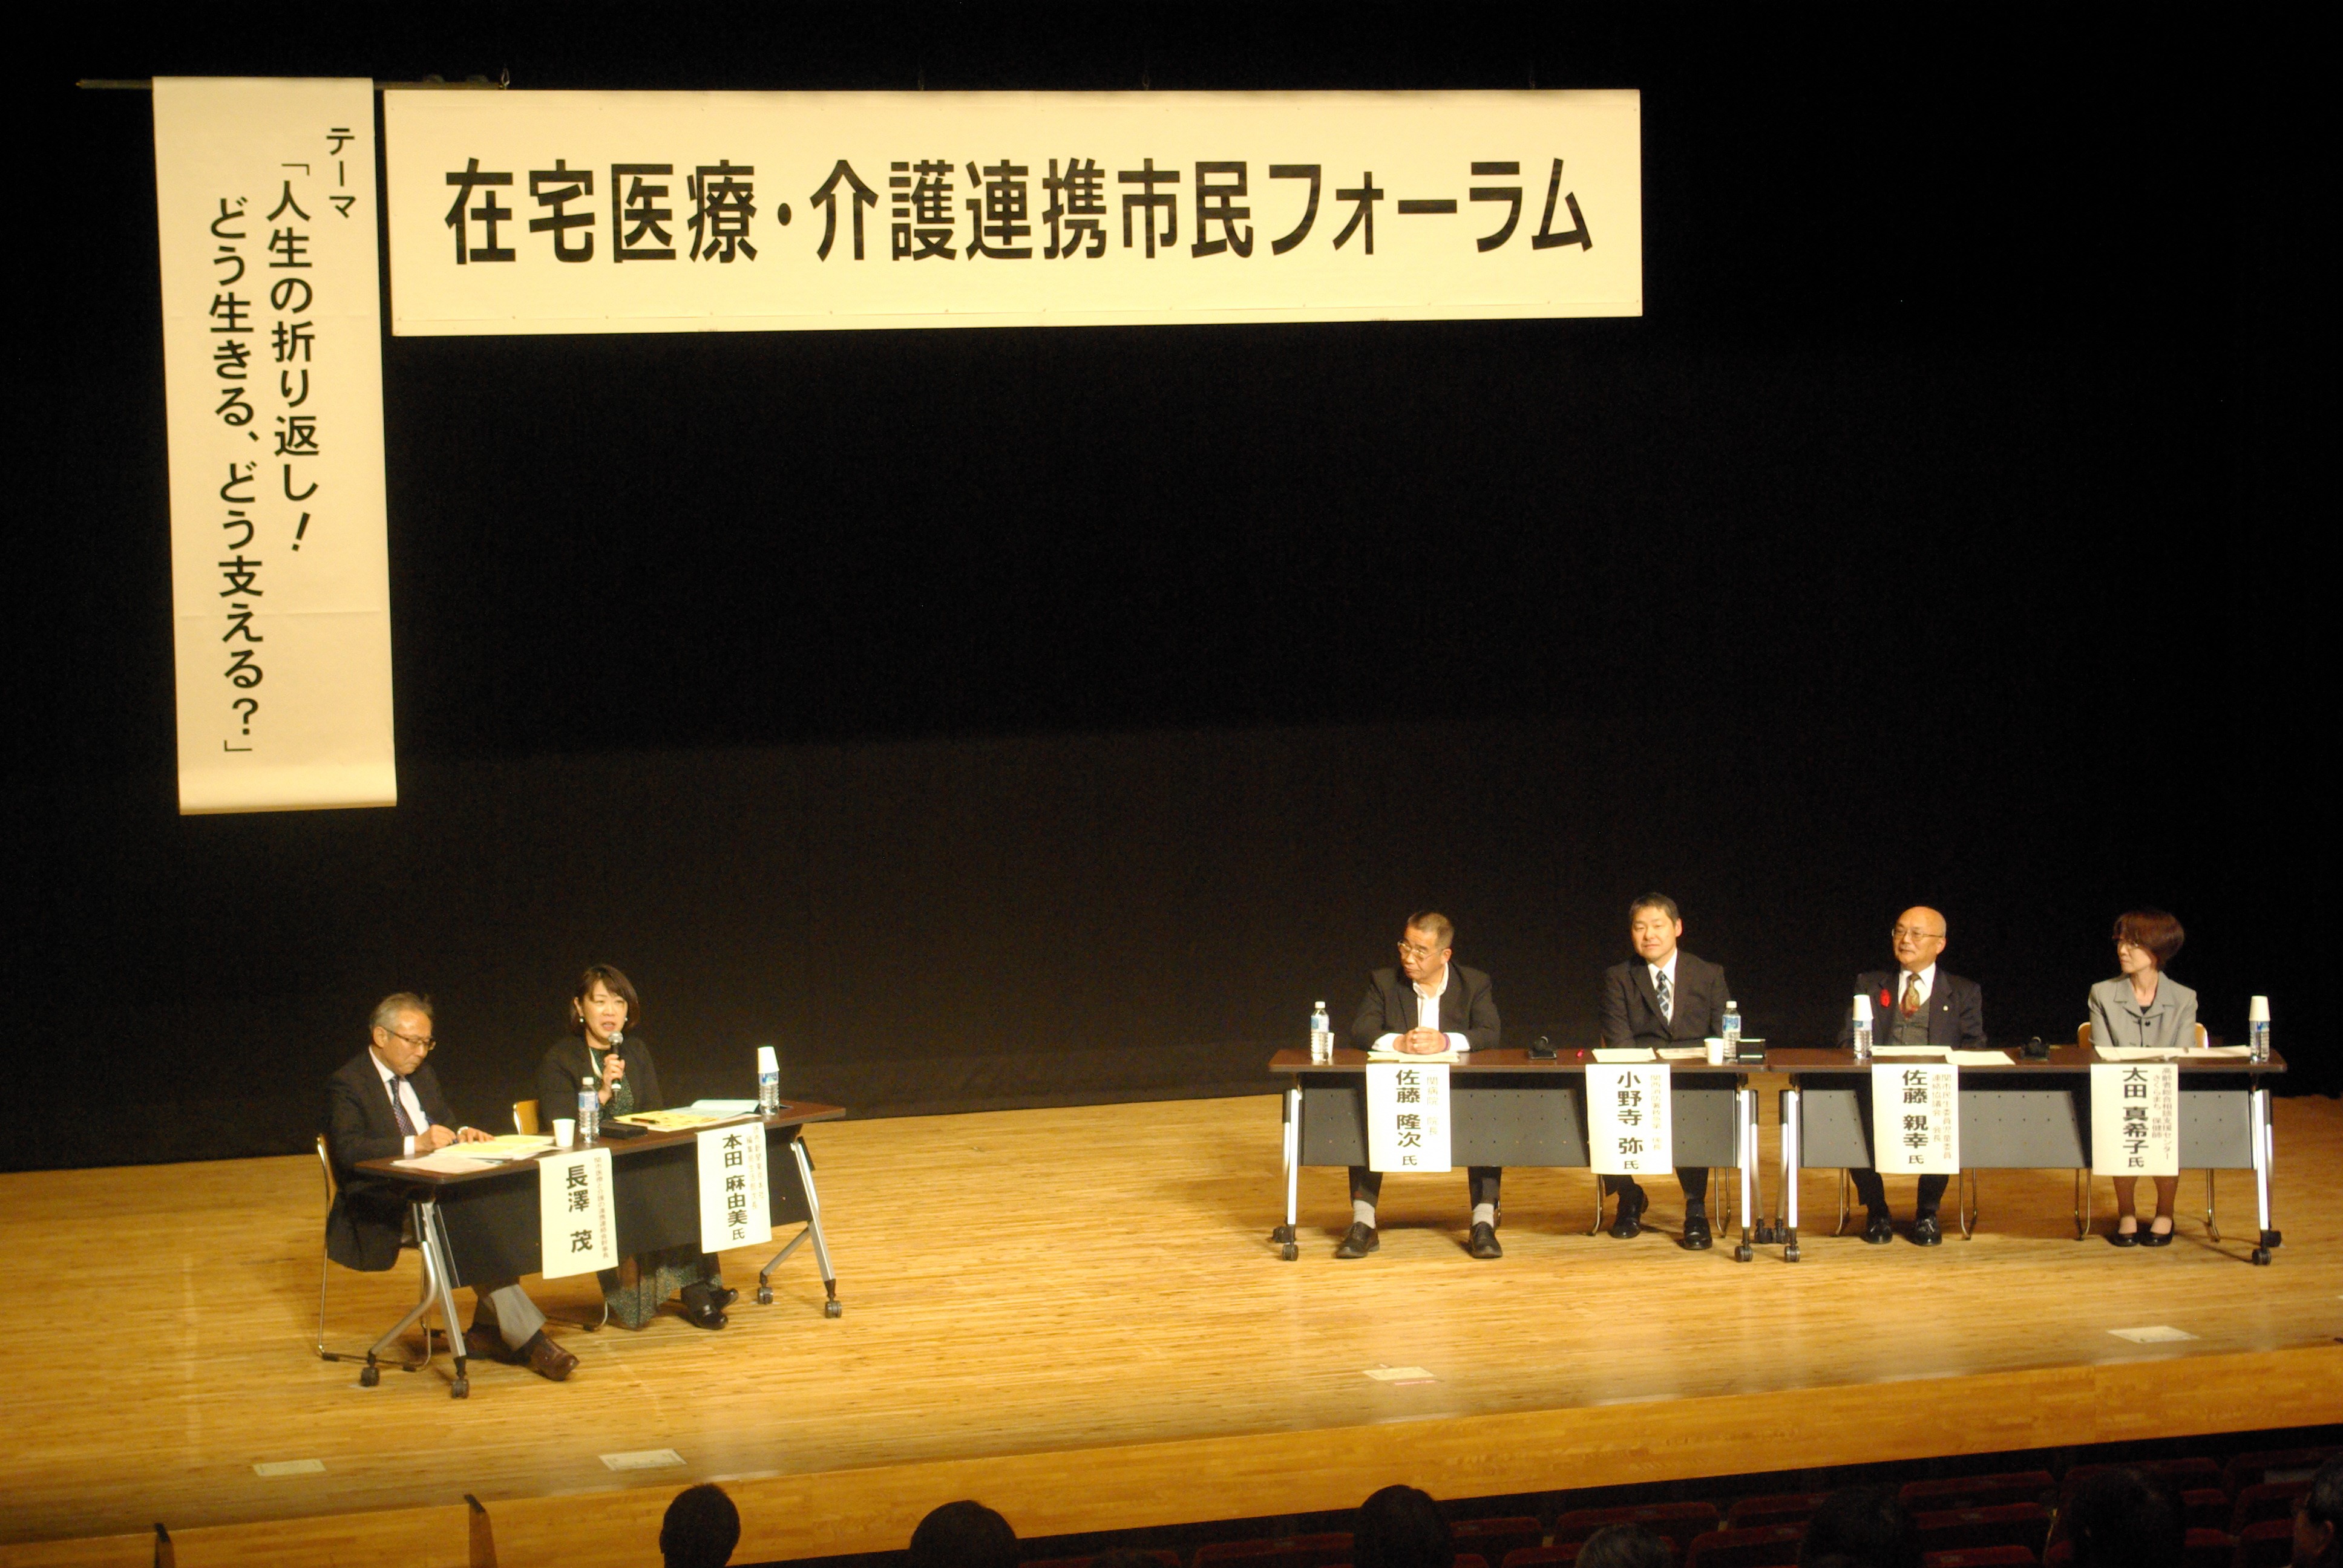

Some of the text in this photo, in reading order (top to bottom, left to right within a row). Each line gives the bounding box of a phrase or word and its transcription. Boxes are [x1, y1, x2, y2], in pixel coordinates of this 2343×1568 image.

[327, 128, 355, 218] テーマ
[445, 158, 1592, 264] 在宅医療・介護連携市民フォーラム
